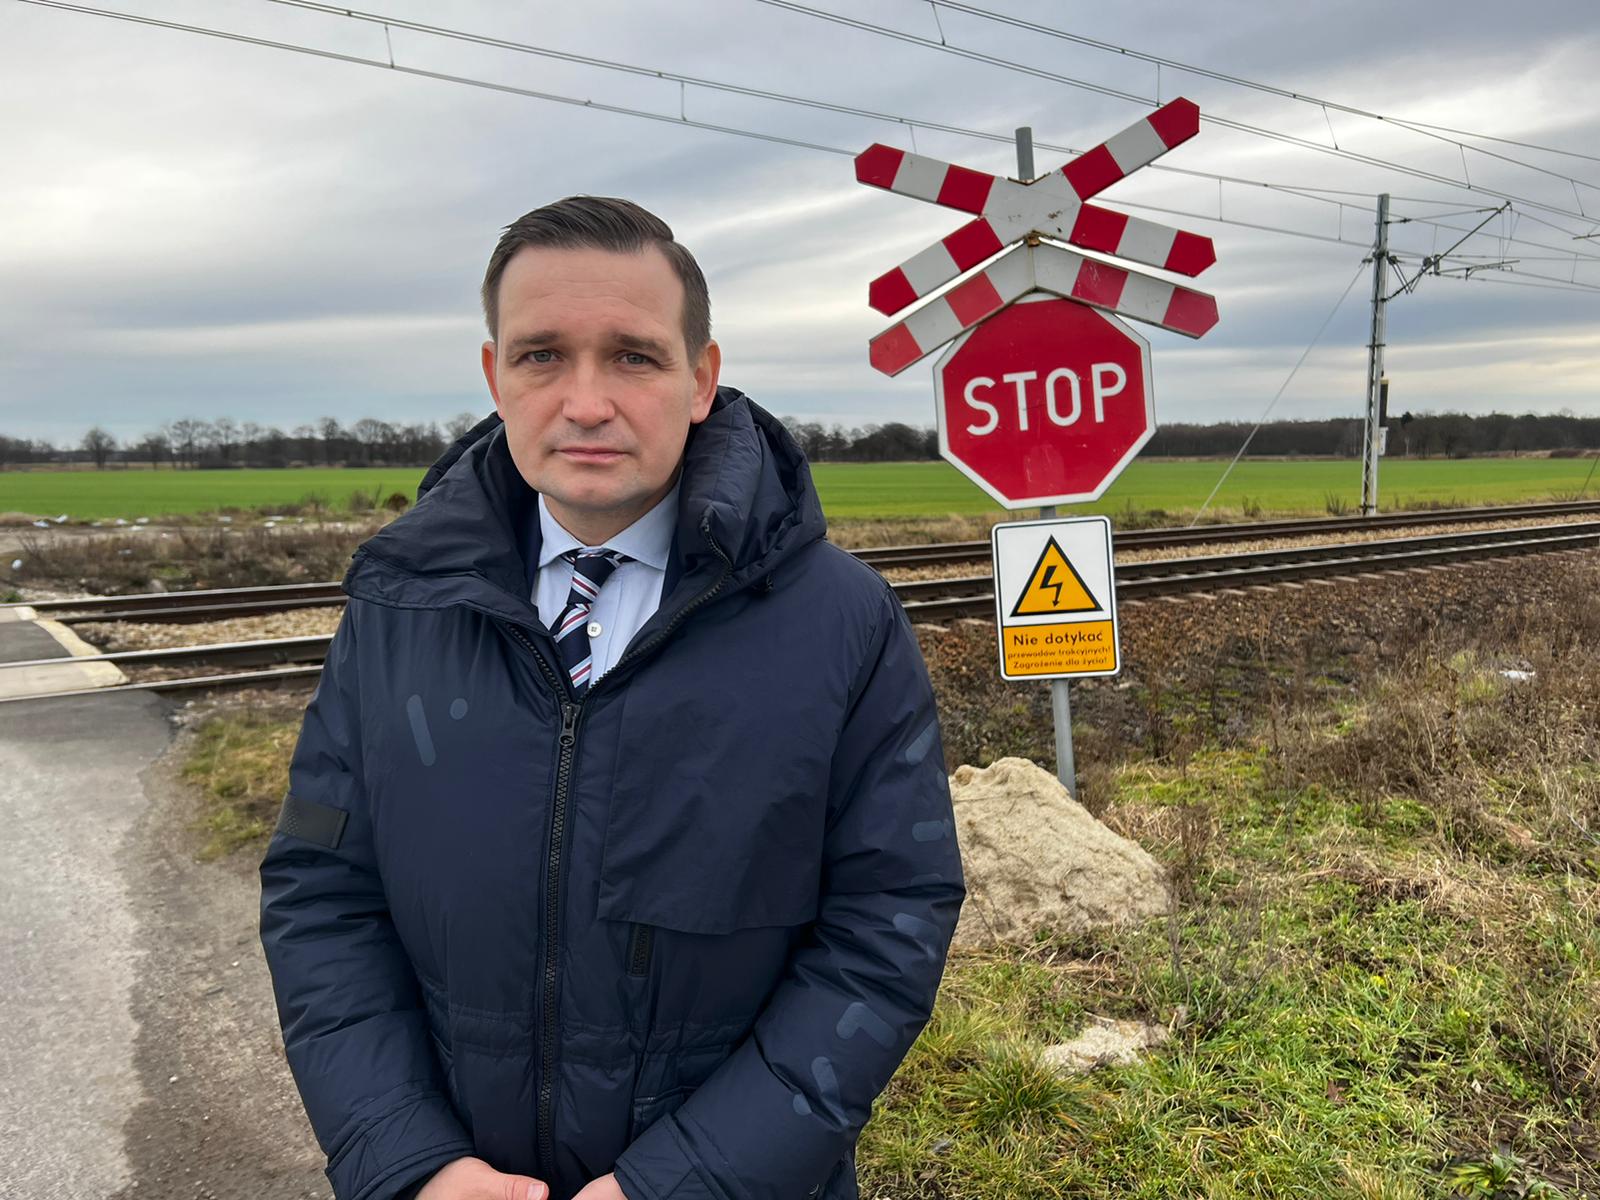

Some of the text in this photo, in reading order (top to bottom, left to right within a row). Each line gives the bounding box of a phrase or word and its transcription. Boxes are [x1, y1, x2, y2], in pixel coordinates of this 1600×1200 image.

[963, 361, 1127, 436] STOP
[1013, 631, 1103, 646] Nie dotykać
[1013, 657, 1107, 670] Zagrożenie dla życia!
